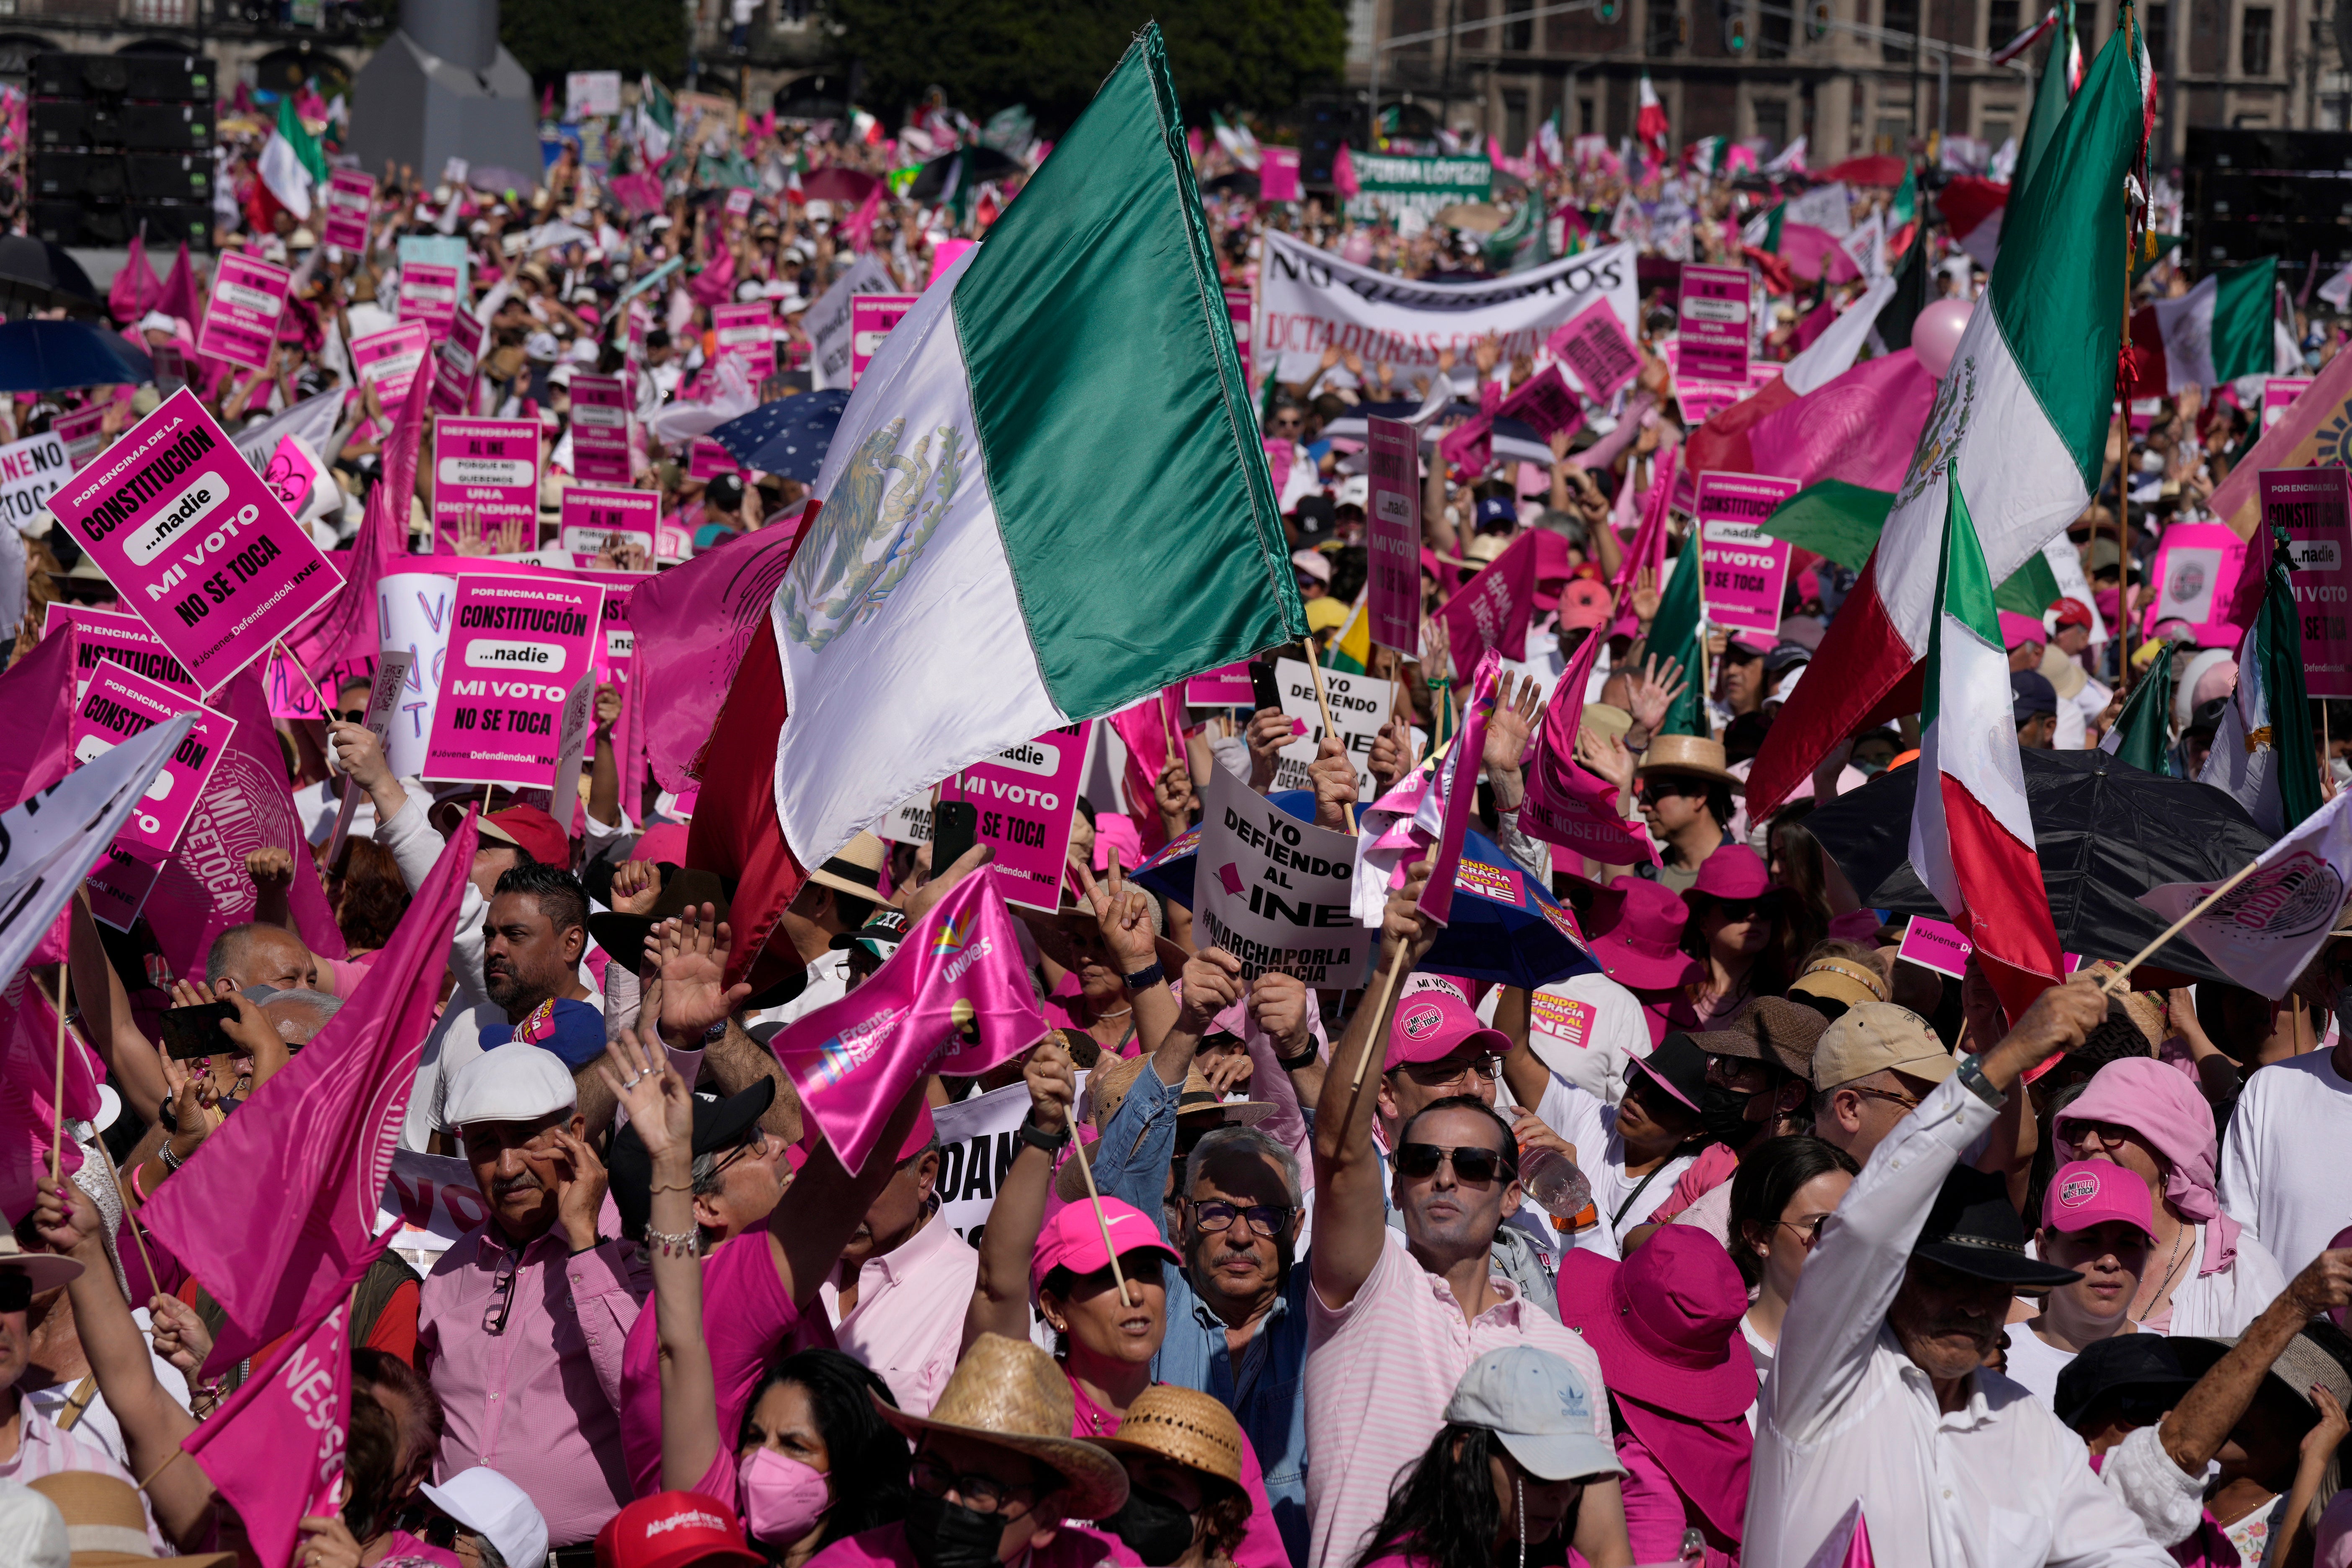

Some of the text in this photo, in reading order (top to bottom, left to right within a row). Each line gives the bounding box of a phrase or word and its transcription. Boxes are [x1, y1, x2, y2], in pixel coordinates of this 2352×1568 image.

[441, 425, 534, 439] DEFENDEMOS
[72, 417, 183, 507] POR ENCIMA DE LA
[81, 425, 216, 542] CONSTITUCIÓN
[466, 487, 504, 500] UNA
[437, 501, 534, 516] DICTADURA
[1700, 495, 1779, 520] CONSTITUCIÓ
[145, 504, 259, 601] MI VOTO
[1720, 550, 1776, 570] VOTO
[174, 534, 282, 628] NO SE TOCA
[294, 560, 322, 585] INE
[1714, 572, 1729, 589] SE
[1733, 573, 1765, 593] TOCA
[471, 588, 583, 604] POR ENCIMA DE LA
[2305, 586, 2347, 603] VOTO
[77, 623, 92, 633] OR
[94, 626, 149, 643] ENCIMA
[460, 607, 588, 637] CONSTITUCIÓN
[2305, 616, 2347, 641] SE TOCA
[479, 645, 549, 664] ...nadie
[452, 680, 566, 703] MI VOTO
[1328, 676, 1351, 692] YO
[105, 678, 127, 694] POR
[126, 689, 171, 717] ENCIMA
[454, 708, 552, 736] NO SE TOCA
[537, 756, 554, 766] IN
[954, 772, 1060, 811] MI VOTO
[982, 811, 1046, 849] SE TOCA
[1267, 812, 1302, 846] YO
[1224, 806, 1352, 879] DEFIENDO
[1031, 872, 1056, 886] INE
[1263, 866, 1293, 890] AL
[1494, 879, 1513, 890] AL
[107, 886, 136, 905] INE
[1455, 877, 1516, 903] NE
[1248, 884, 1354, 928] INE
[1202, 908, 1351, 966] #MARCHAPORLA
[1416, 978, 1430, 988] MI
[838, 1007, 894, 1044] Frente
[1406, 1008, 1436, 1027] #MIVOTO
[1408, 1016, 1441, 1036] NOSETOCA
[1529, 1014, 1583, 1044] NE
[1566, 1017, 1583, 1029] AL
[2063, 1179, 2095, 1193] #MIVOTO
[2063, 1186, 2094, 1200] NOSETOCA
